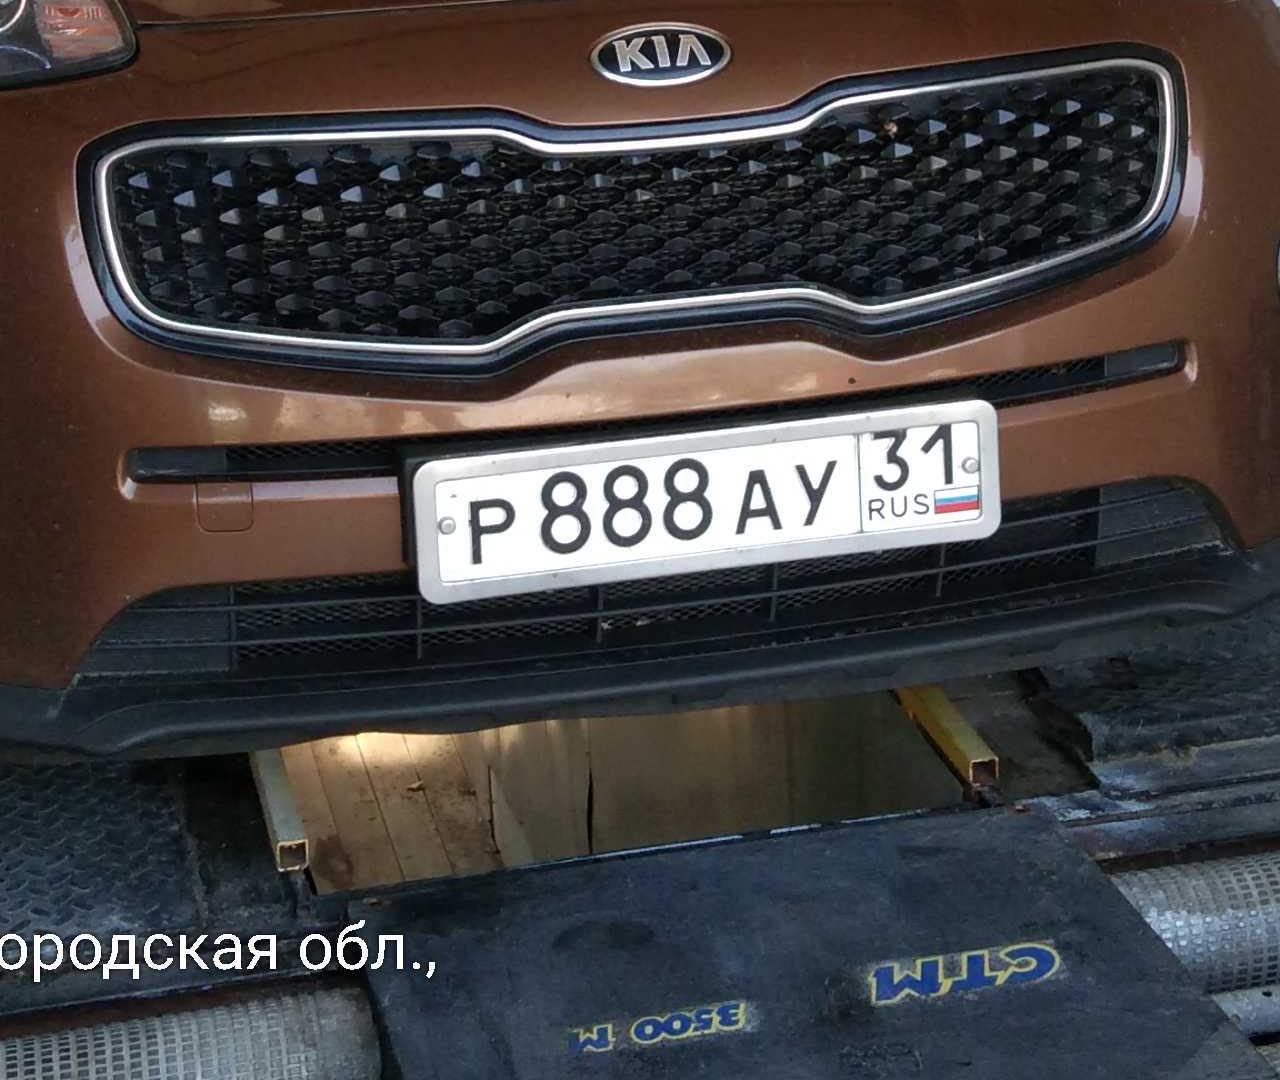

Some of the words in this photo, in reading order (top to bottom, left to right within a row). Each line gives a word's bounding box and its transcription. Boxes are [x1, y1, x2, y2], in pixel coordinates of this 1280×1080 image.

[611, 34, 712, 73] KIA
[872, 423, 954, 491] 31
[868, 493, 930, 520] RUS
[630, 1000, 747, 1044] 3500
